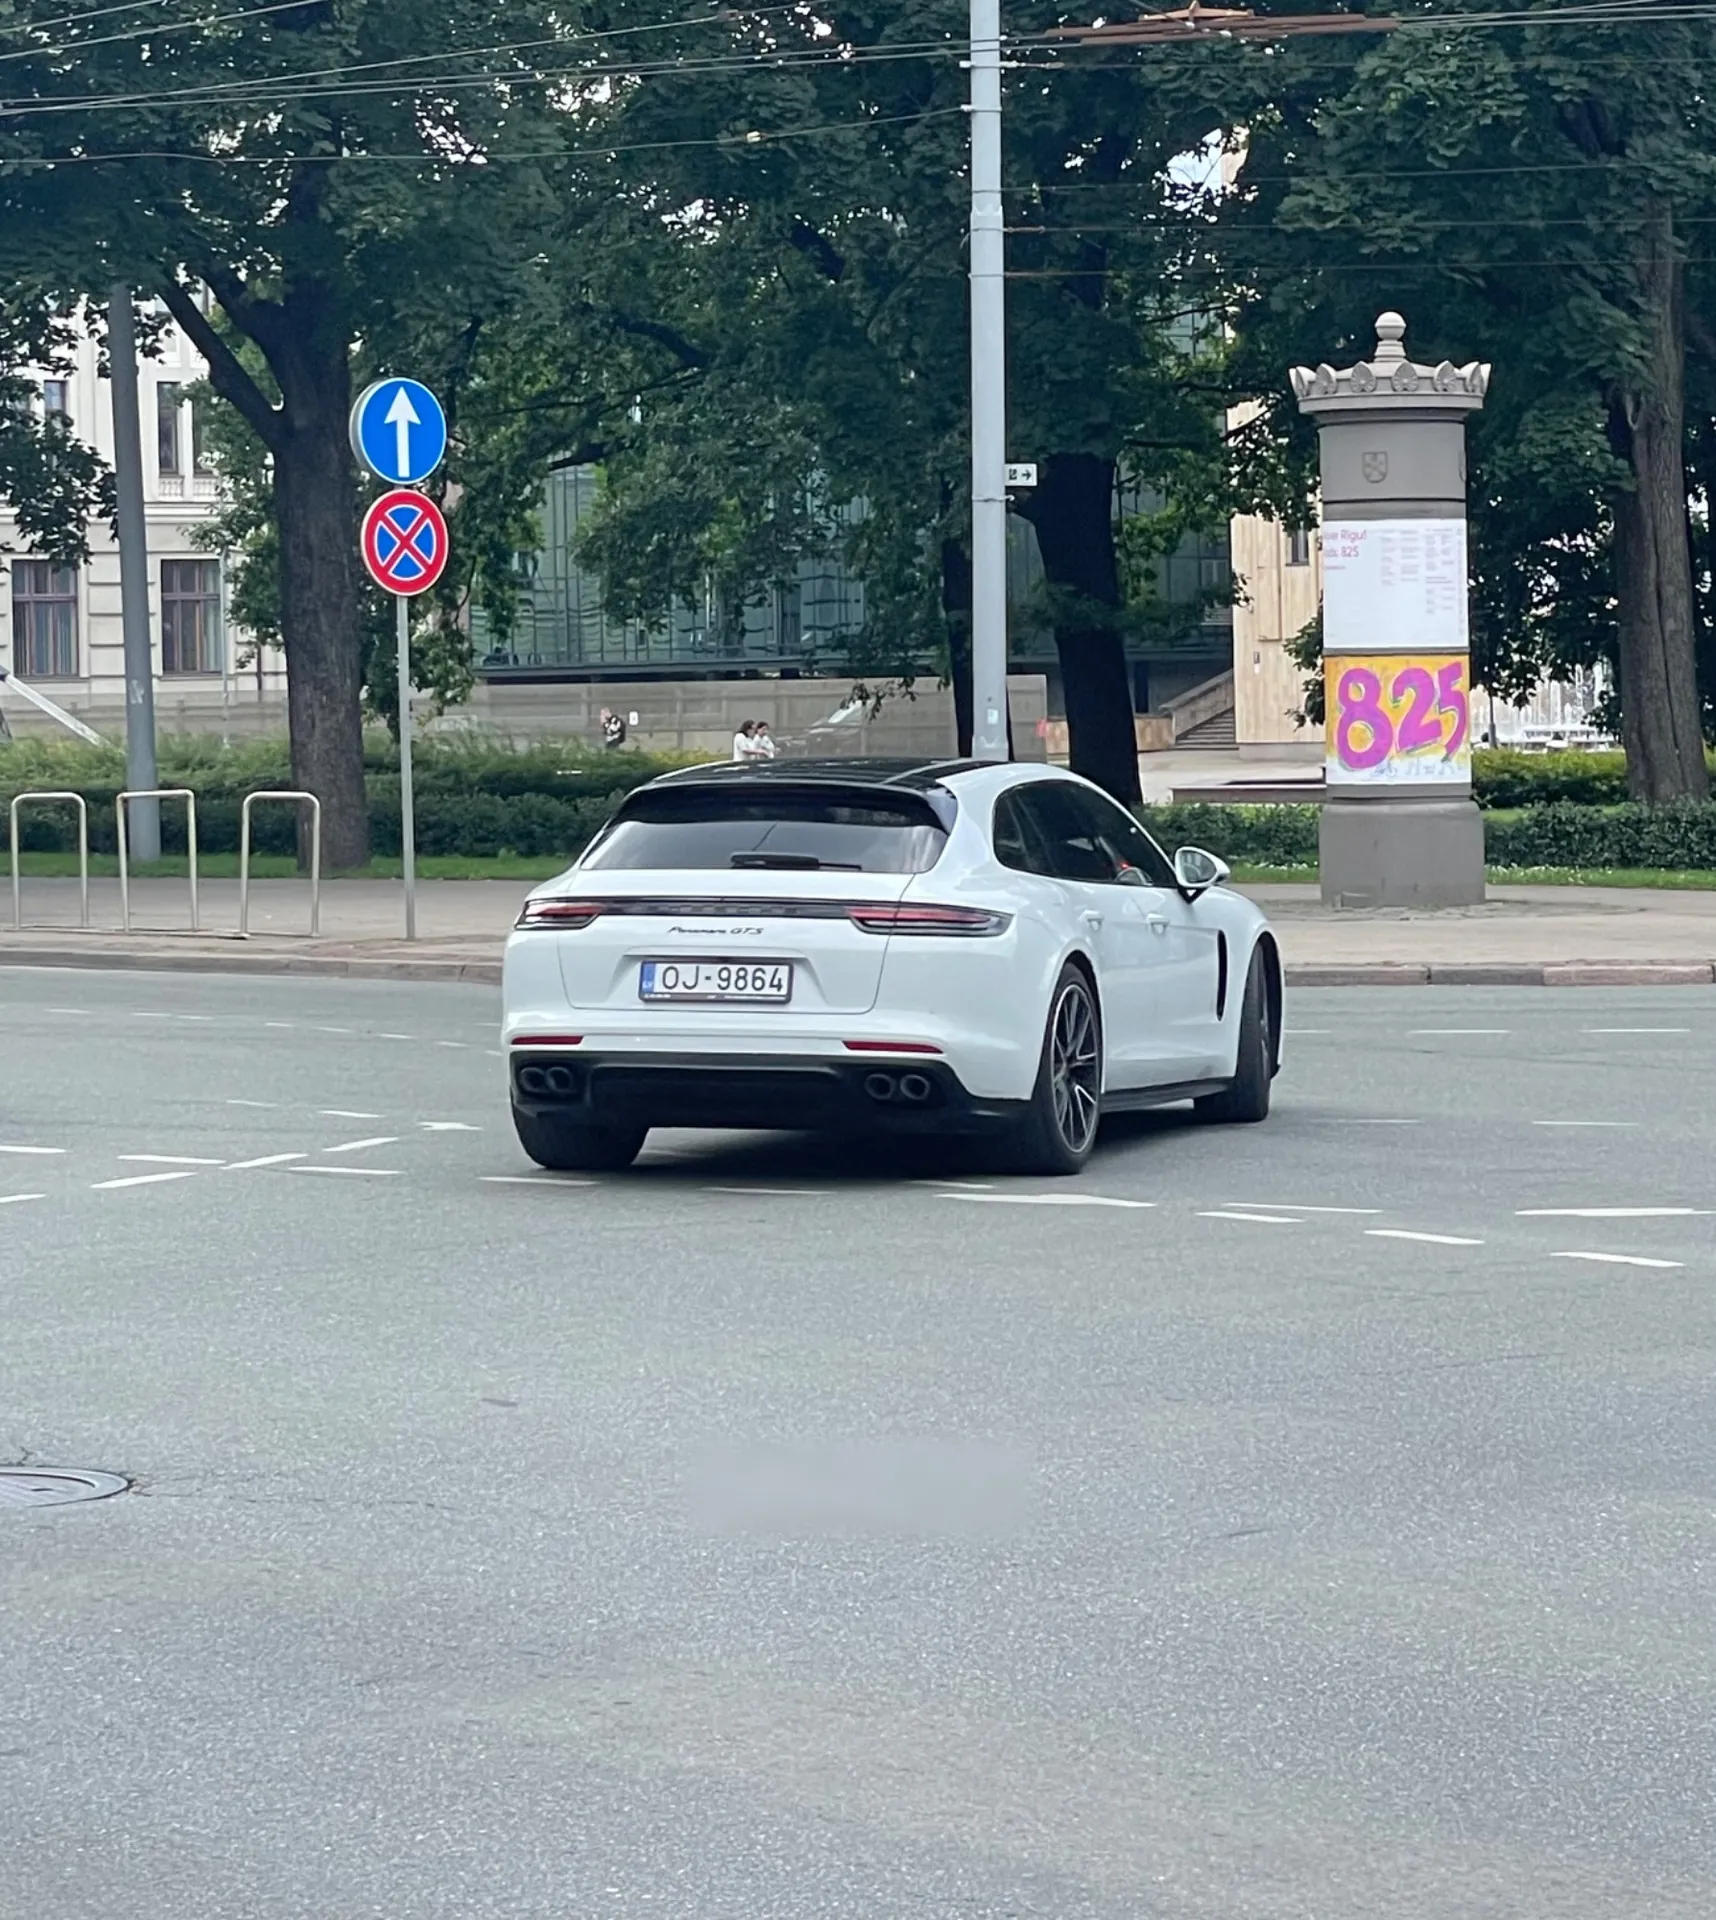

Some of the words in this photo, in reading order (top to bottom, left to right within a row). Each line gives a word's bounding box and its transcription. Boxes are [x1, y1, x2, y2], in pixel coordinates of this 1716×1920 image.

[1341, 545, 1359, 557] 825
[1336, 660, 1467, 770] 825
[730, 927, 764, 936] GTS
[662, 965, 783, 992] OJ-9864
